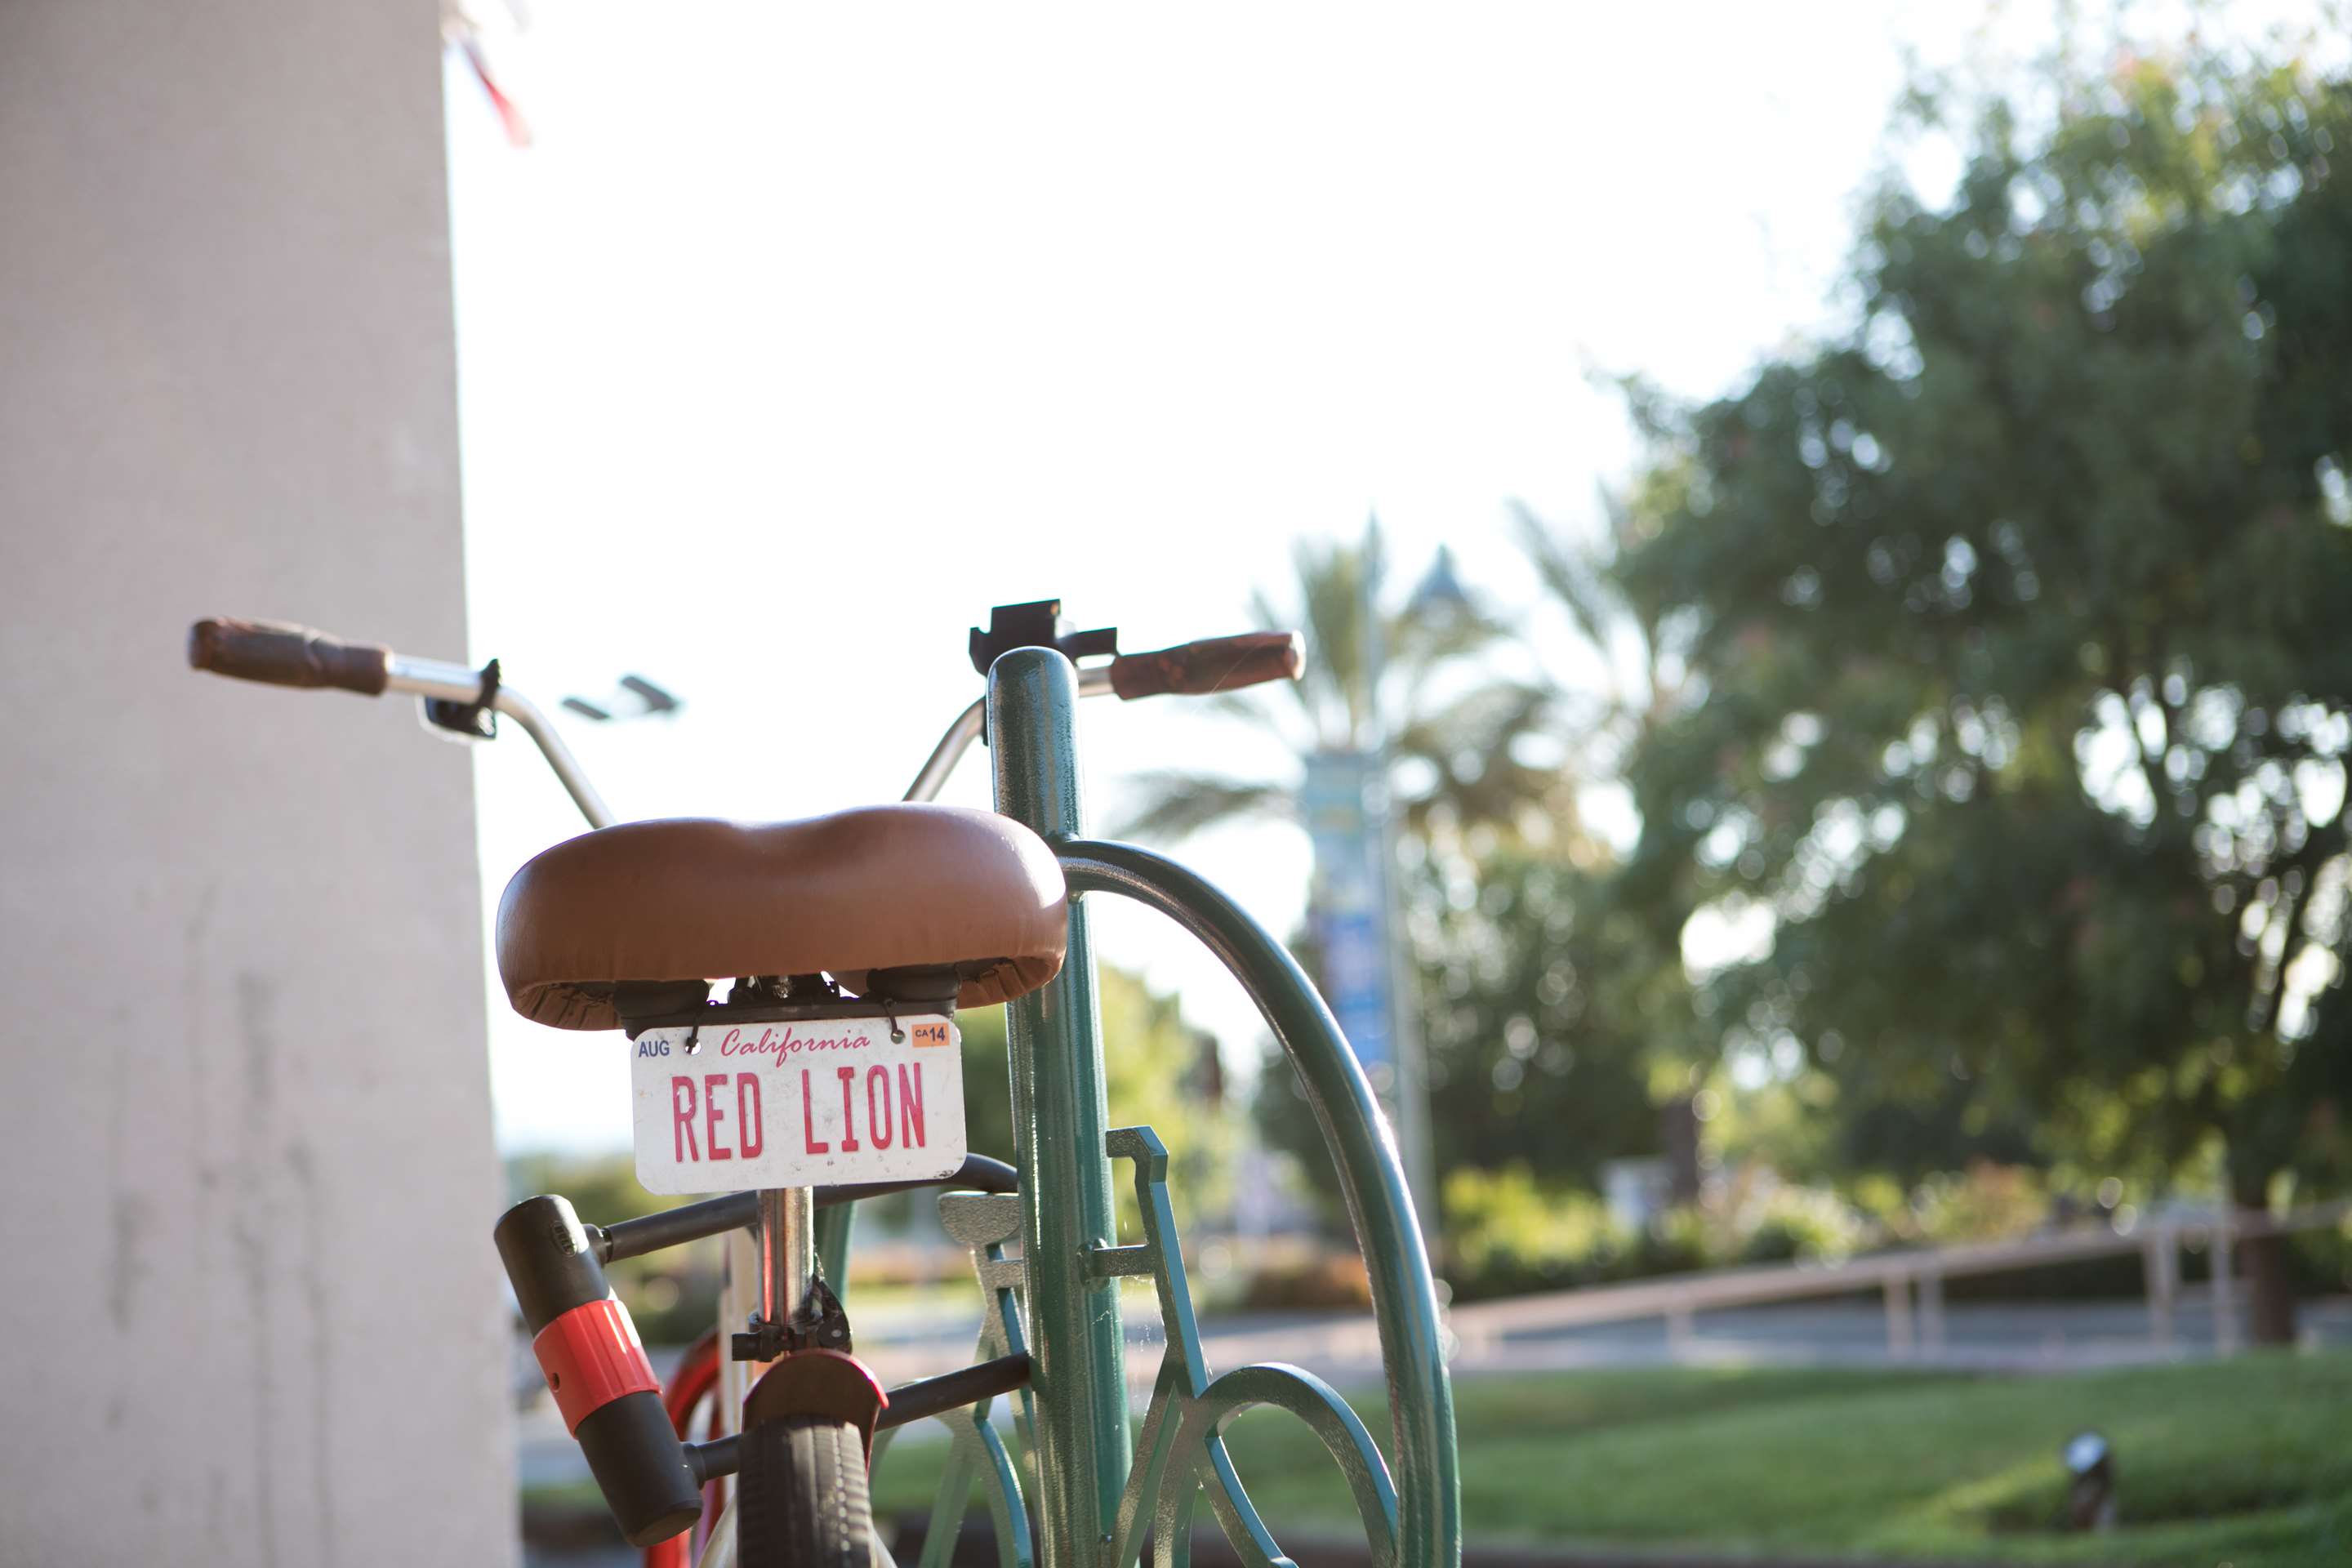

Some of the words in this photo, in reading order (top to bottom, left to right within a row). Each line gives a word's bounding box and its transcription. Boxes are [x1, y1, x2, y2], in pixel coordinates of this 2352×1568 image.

[720, 1027, 871, 1068] California
[915, 1029, 929, 1037] CA
[929, 1026, 946, 1041] 14
[638, 1040, 670, 1058] AUG
[671, 1071, 763, 1163] RED
[800, 1062, 926, 1155] LION
